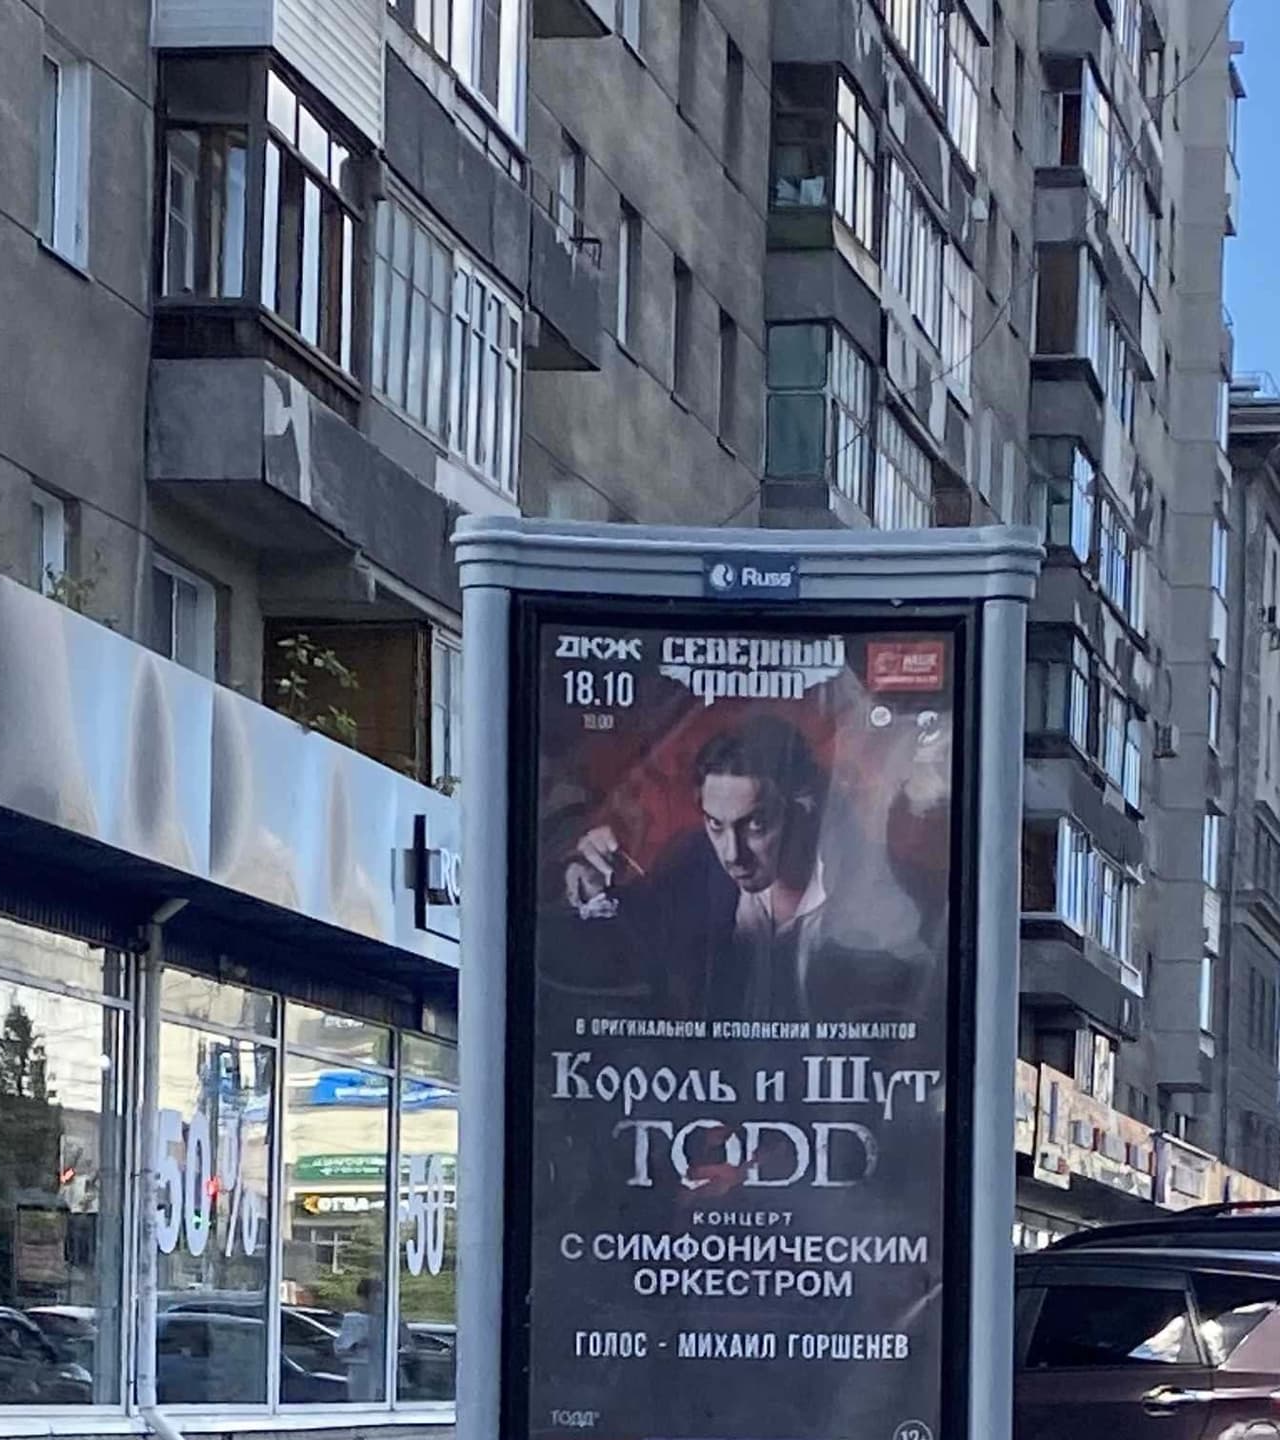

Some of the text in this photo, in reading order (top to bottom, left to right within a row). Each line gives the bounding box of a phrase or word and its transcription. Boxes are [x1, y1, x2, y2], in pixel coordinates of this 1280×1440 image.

[563, 670, 634, 707] 18.10
[576, 1019, 916, 1040] В ОРИГИНАЛЬНОМ ИСПОЛНЕНИИ МУЗЫКАНТОВ
[552, 1051, 941, 1120] Король и Шут
[613, 1120, 878, 1190] TODD
[693, 1211, 793, 1228] КОНЦЕРТ
[560, 1232, 928, 1264] С СИМФОНИЧЕСКИМ
[634, 1268, 852, 1297] ОРКЕСТРОМ
[575, 1331, 648, 1357] ГОЛОС
[677, 1332, 776, 1359] МИХАИЛ
[787, 1333, 909, 1360] ГОРШЕНЕВ
